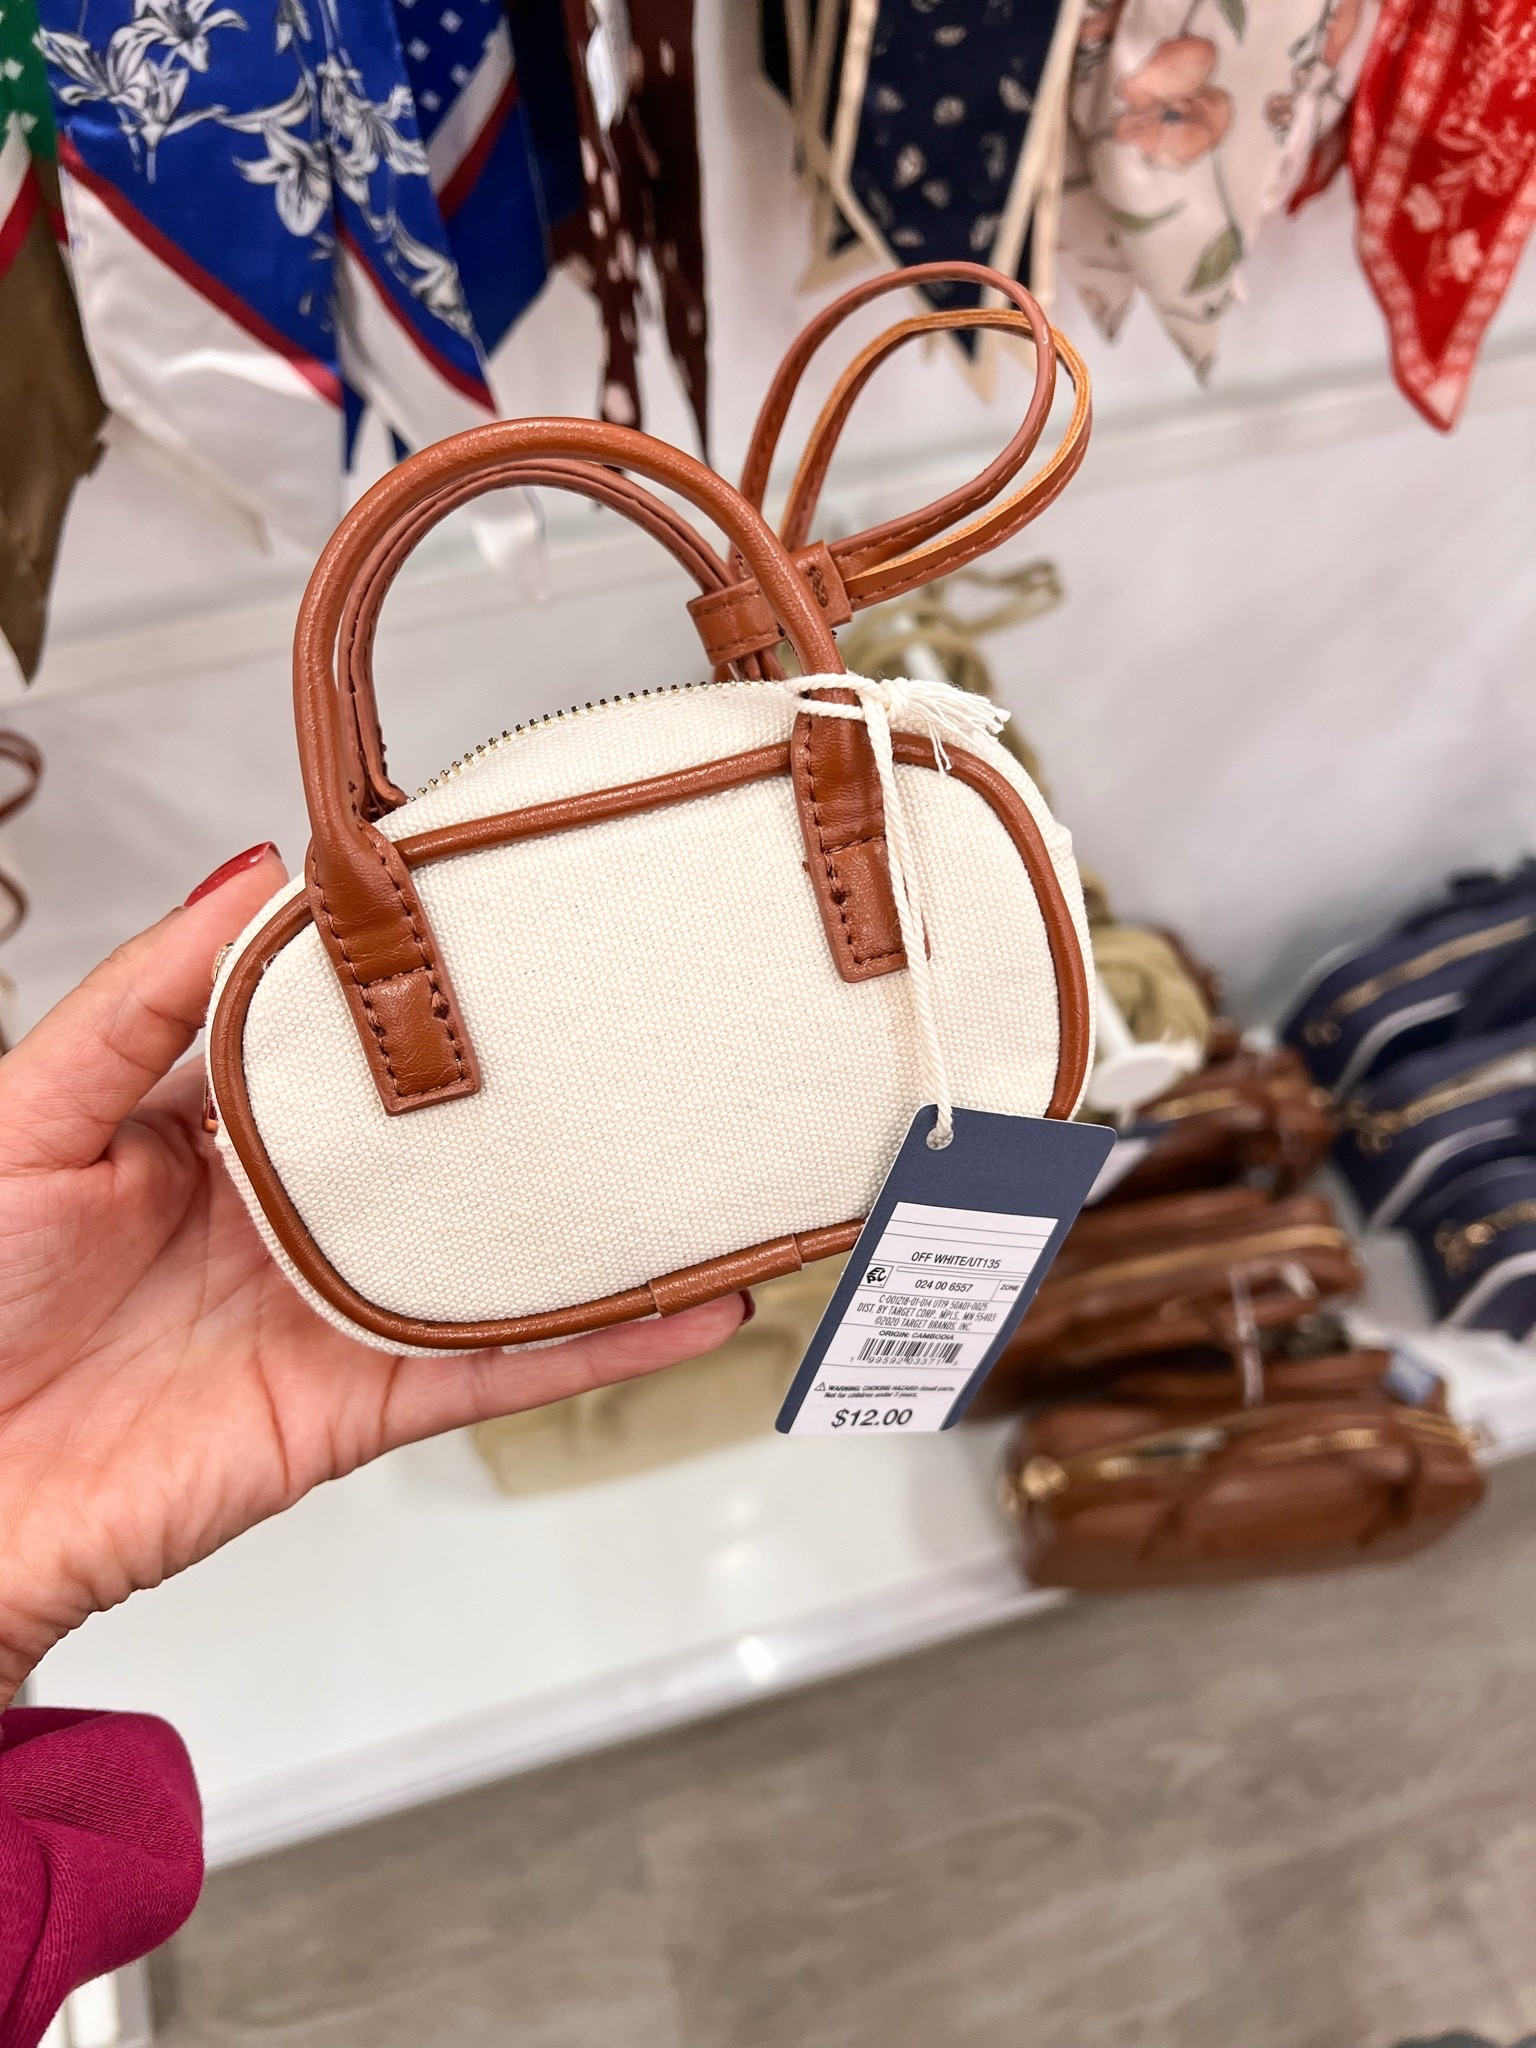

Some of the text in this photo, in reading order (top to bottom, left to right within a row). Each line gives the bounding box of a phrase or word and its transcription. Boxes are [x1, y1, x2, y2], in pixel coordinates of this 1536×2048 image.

[911, 1251, 1002, 1269] OFF WHITE/UT135
[915, 1279, 974, 1293] 024 00 6557
[856, 1302, 875, 1314] DIST.
[876, 1304, 888, 1314] BY
[888, 1305, 916, 1317] TARGET
[962, 1311, 976, 1321] MN
[975, 1312, 997, 1322] 55403
[900, 1318, 928, 1329] TARGET
[878, 1330, 954, 1340] ORIGIN: CAMBODIA
[830, 1407, 913, 1429] $12.00
